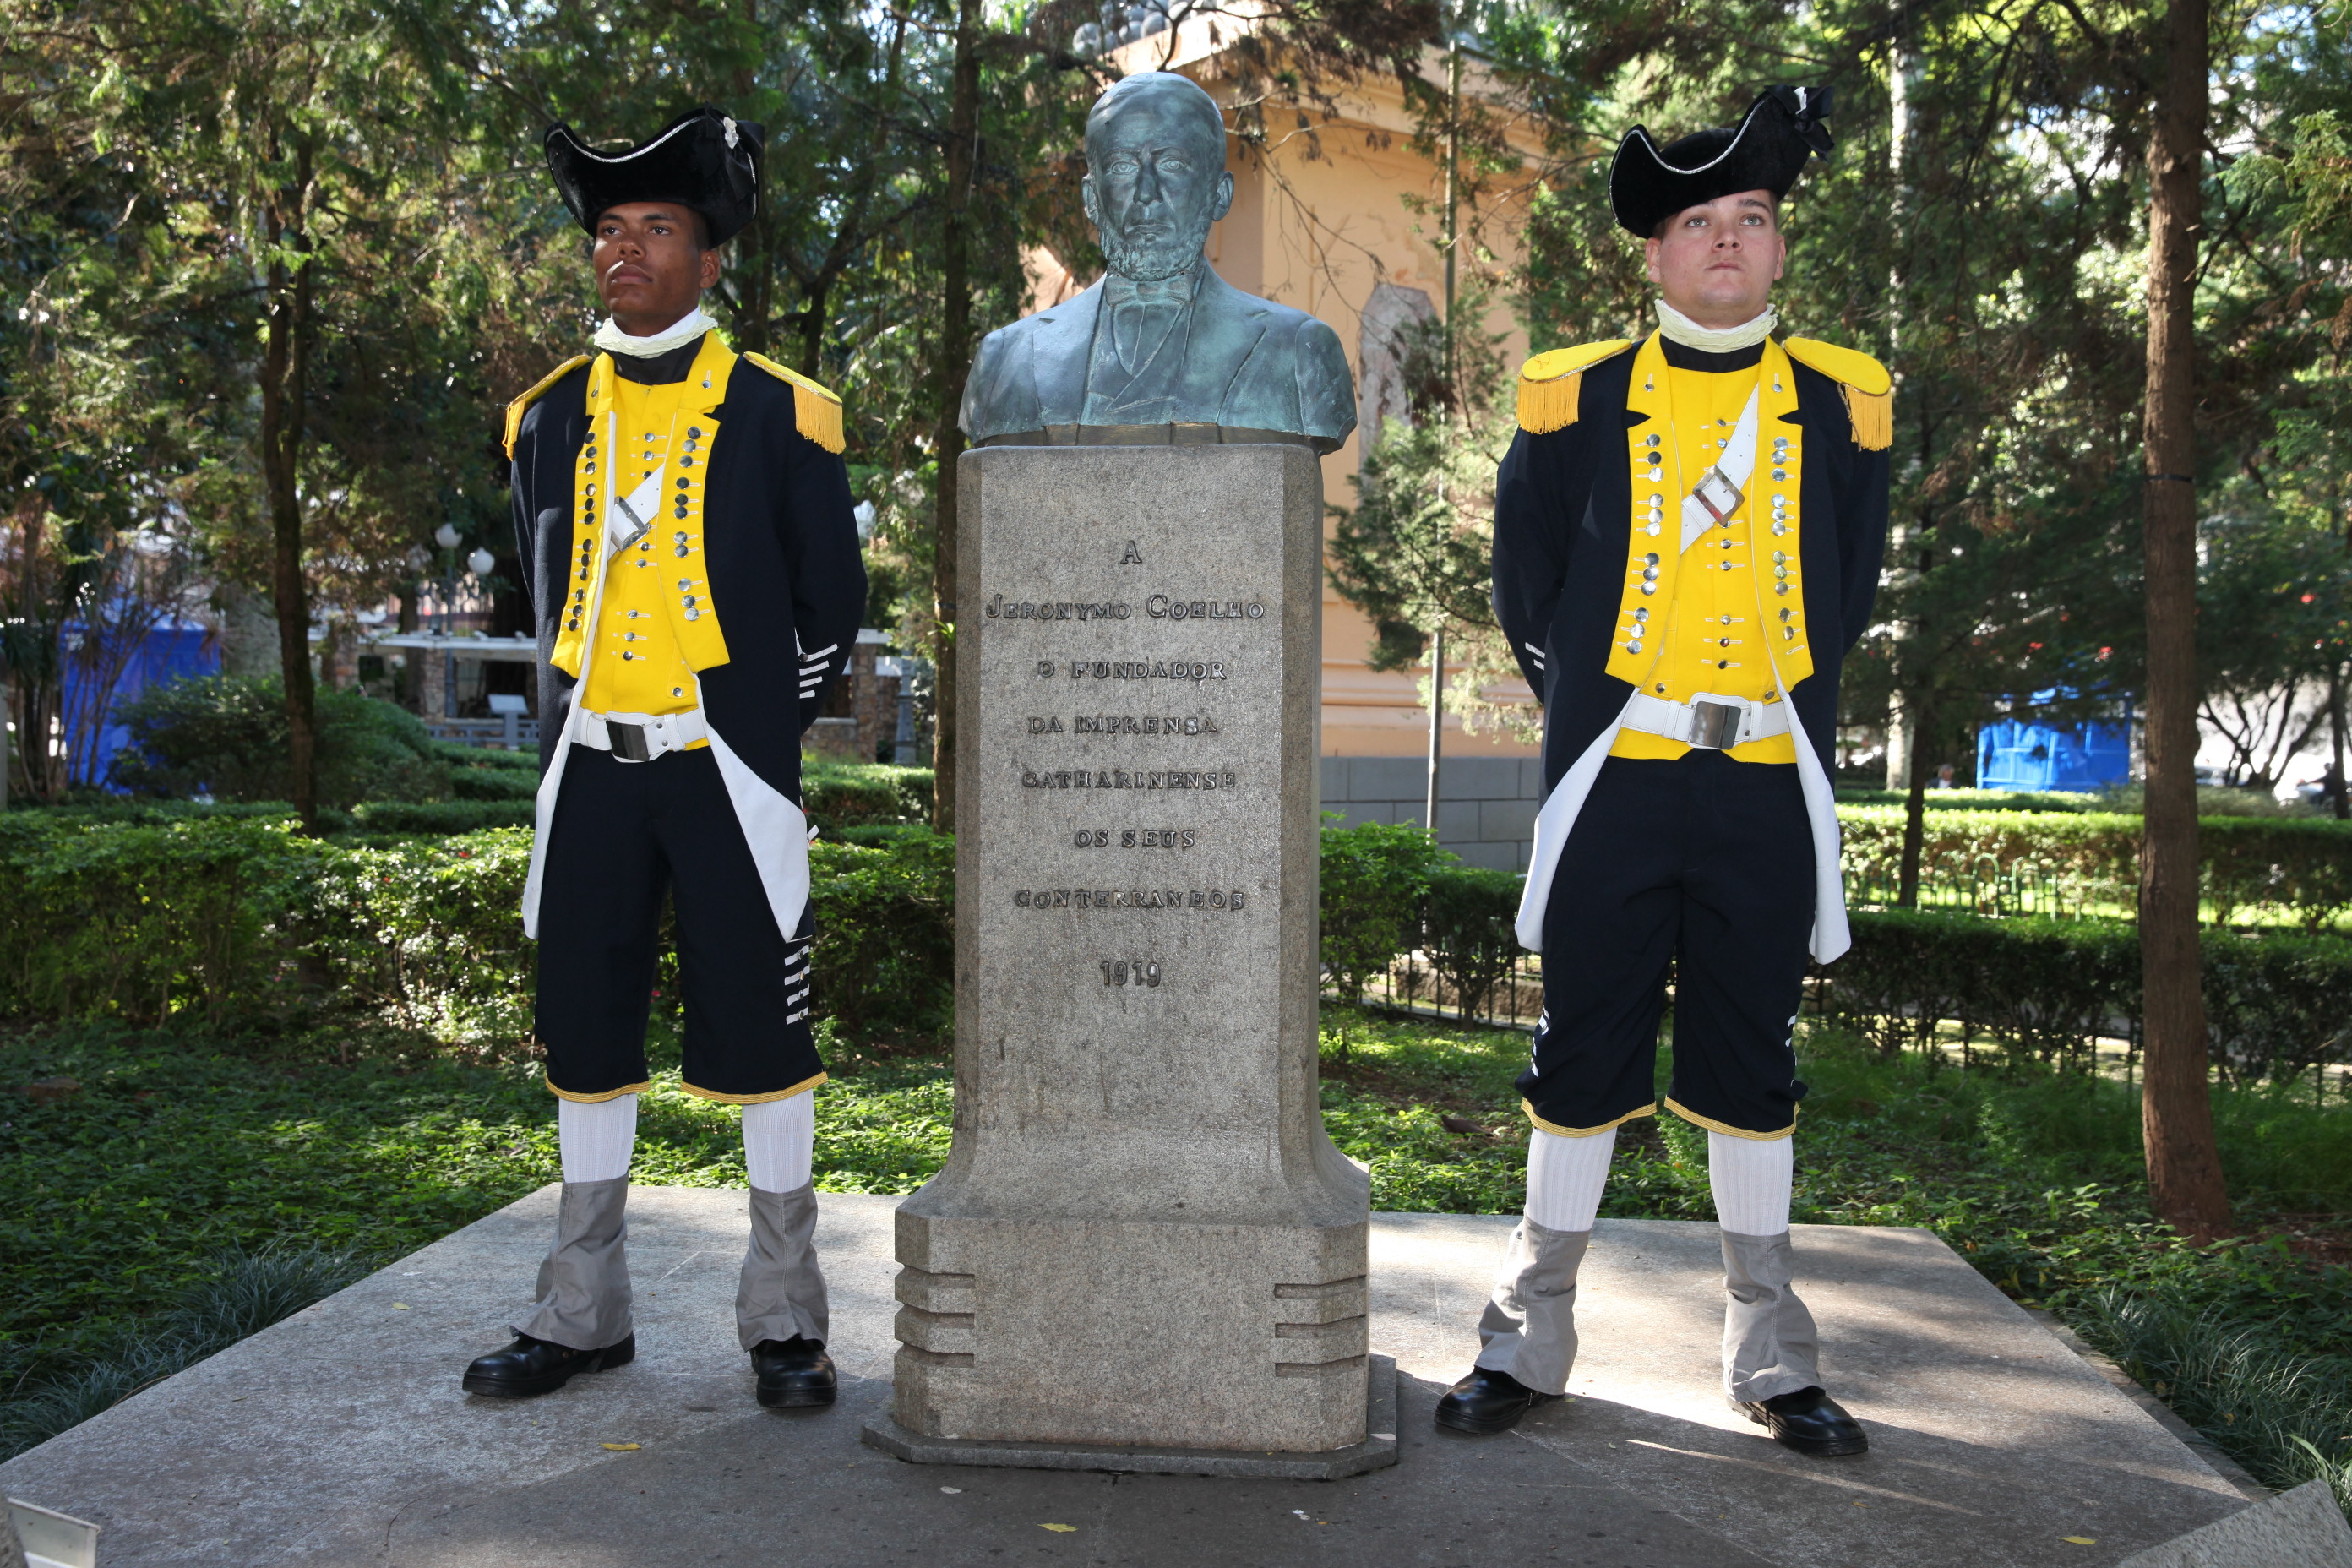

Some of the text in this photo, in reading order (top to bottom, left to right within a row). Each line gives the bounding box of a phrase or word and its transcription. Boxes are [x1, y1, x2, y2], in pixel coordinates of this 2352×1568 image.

[1120, 540, 1142, 564] A
[1038, 662, 1227, 680] O FUNDADOR
[1028, 716, 1217, 736] DA IMPRENSA
[1021, 771, 1236, 790] CATHARINENSE
[1075, 830, 1195, 847] OS SEUS
[1015, 890, 1244, 911] CONTERRANEOS
[1100, 961, 1161, 987] 1919
